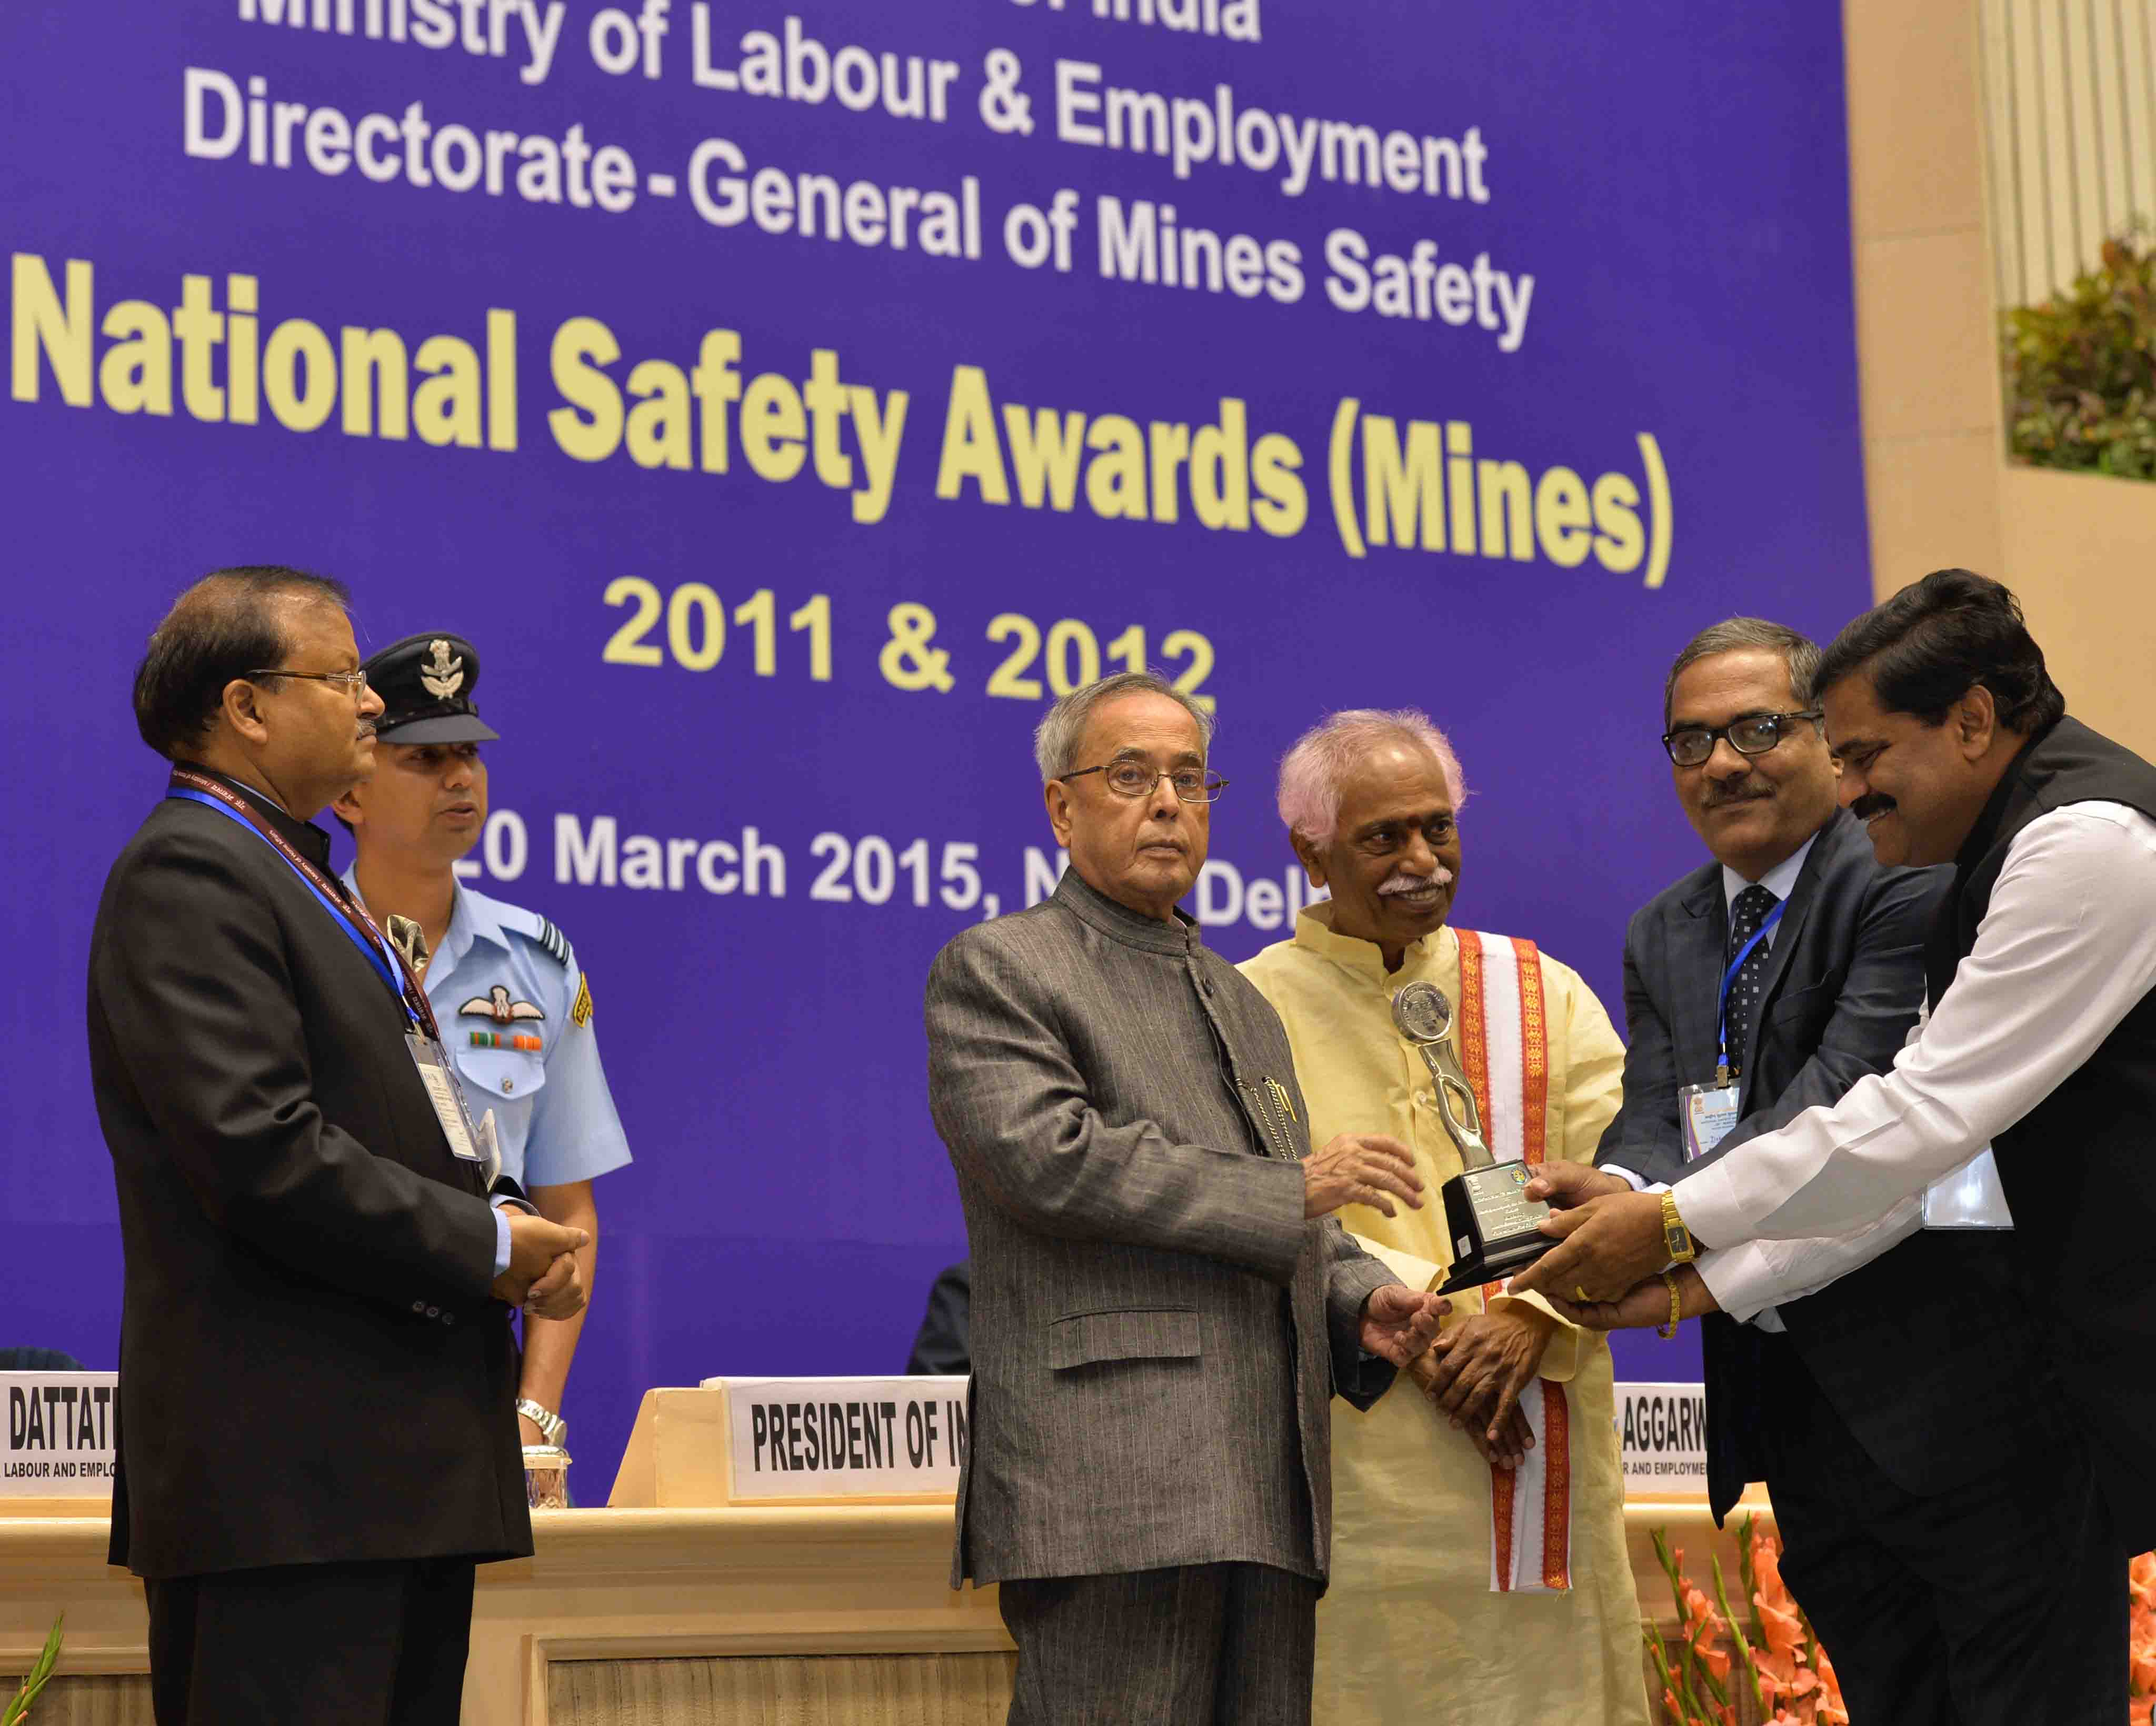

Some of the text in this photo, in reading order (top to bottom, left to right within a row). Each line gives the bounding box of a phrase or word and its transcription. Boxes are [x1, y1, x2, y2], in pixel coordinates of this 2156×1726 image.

[239, 0, 1489, 202] nstry of Labour & Employment
[1005, 189, 1078, 271] of
[1099, 196, 1304, 302] Mines
[1326, 229, 1533, 351] Safety
[12, 254, 1672, 587] National Safety Awards (Mines)
[603, 577, 1215, 714] 2011 & 2012
[453, 810, 527, 881] 0
[555, 815, 785, 896] March
[811, 833, 999, 921] 2015,
[4, 1462, 50, 1477] LABOUR
[53, 1462, 76, 1477] AND
[751, 1401, 896, 1472] PRESIDENT
[905, 1400, 938, 1469] OF
[1632, 1461, 1651, 1475] AND
[1654, 1461, 1706, 1475] EMPLOYME
